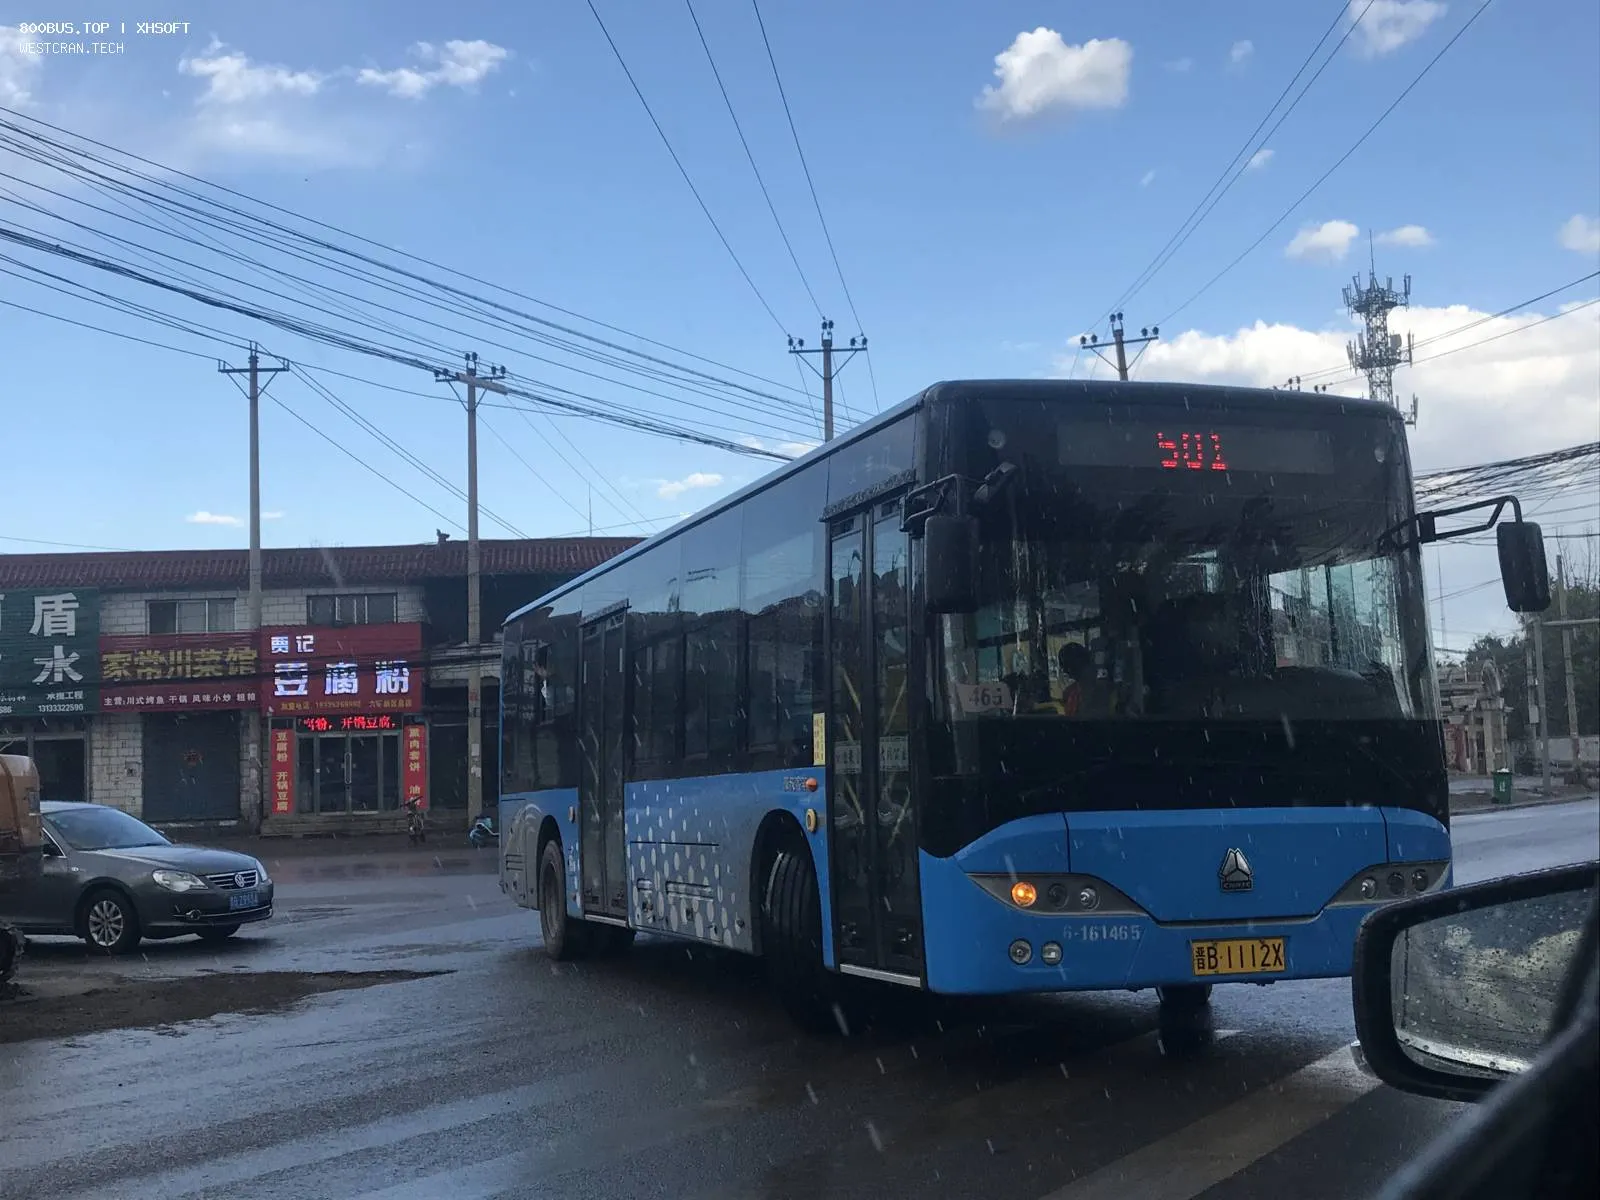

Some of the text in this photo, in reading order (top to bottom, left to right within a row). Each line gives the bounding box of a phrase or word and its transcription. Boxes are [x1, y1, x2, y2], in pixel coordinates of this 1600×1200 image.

[1156, 432, 1228, 470] 501
[271, 635, 314, 653] 贾记
[102, 647, 257, 681] 家常川菜馆
[274, 660, 409, 696] 豆腐粉
[1063, 924, 1141, 941] 6-161465
